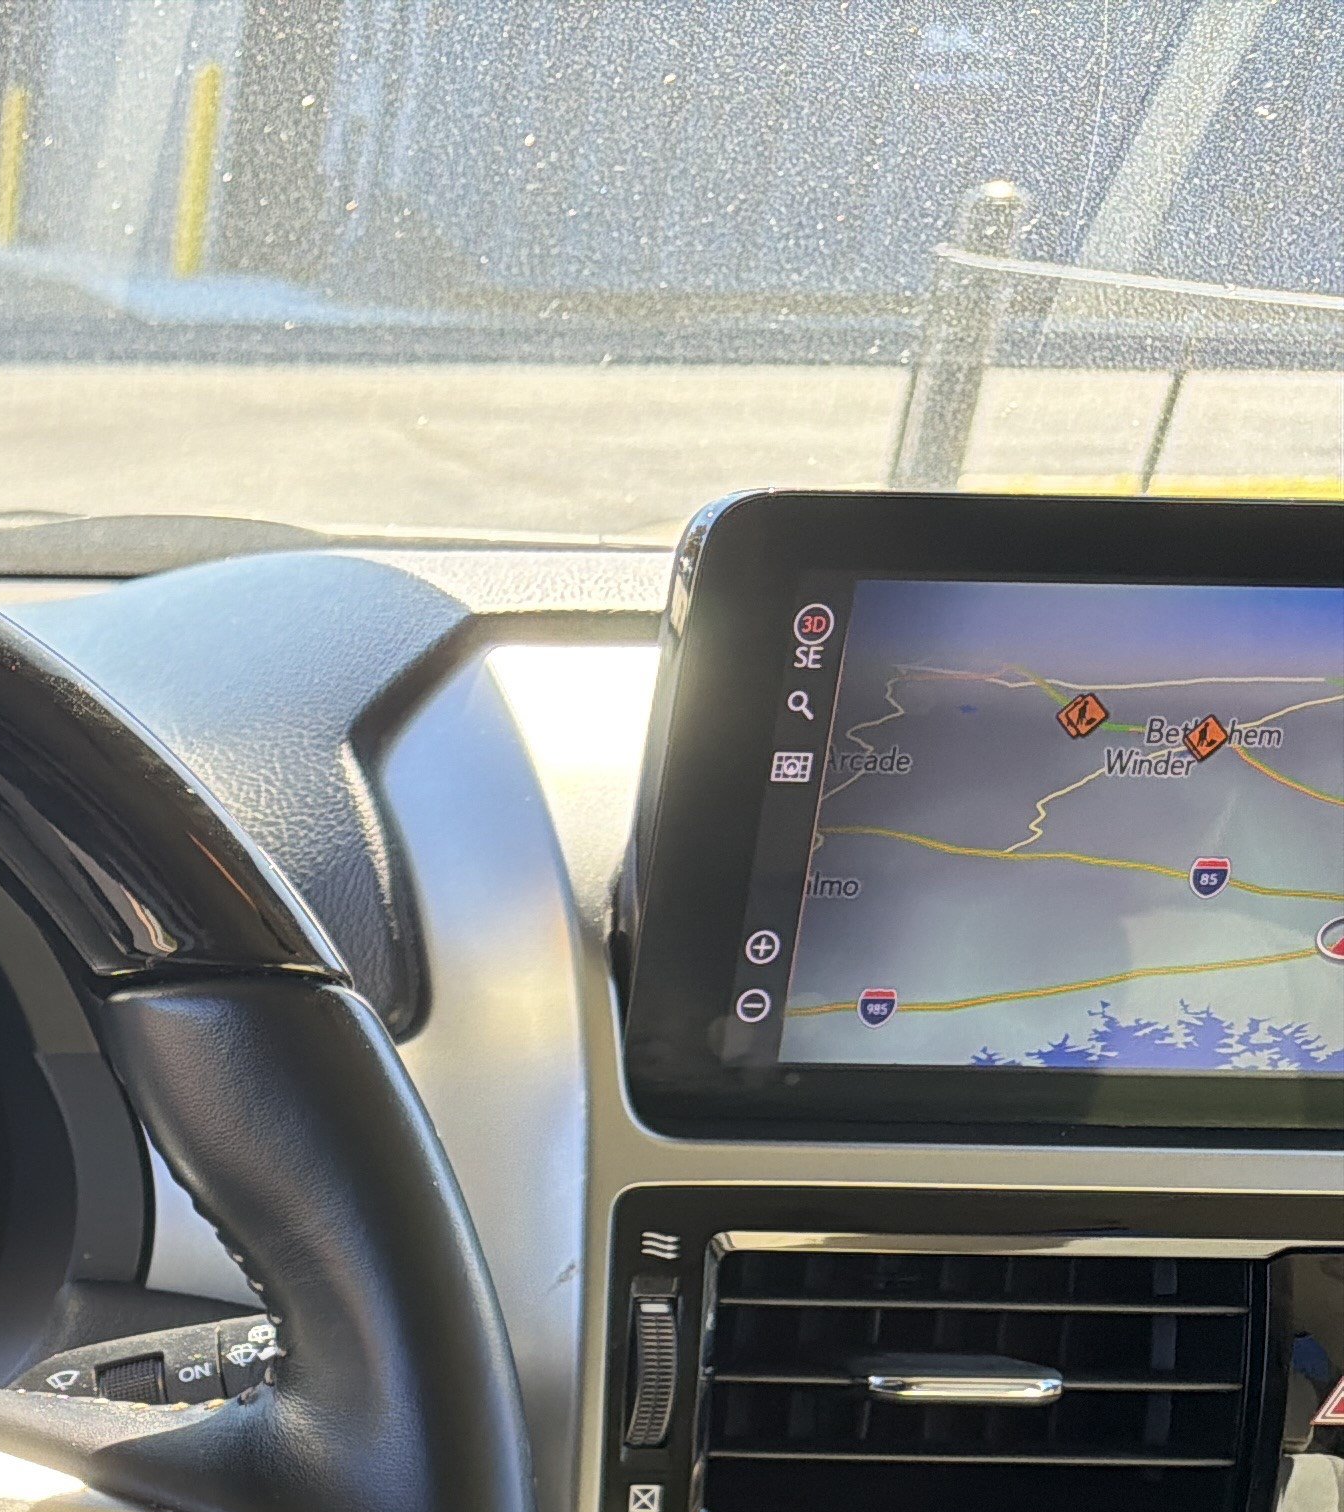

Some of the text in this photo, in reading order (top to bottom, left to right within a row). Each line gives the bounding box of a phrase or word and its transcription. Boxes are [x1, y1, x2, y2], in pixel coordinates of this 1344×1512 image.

[801, 616, 827, 634] 3D
[794, 647, 823, 669] SE
[1146, 718, 1282, 746] Bethem
[1107, 749, 1196, 776] Winder
[1200, 872, 1218, 888] 85
[866, 1002, 887, 1017] 985
[178, 1362, 213, 1383] ON
